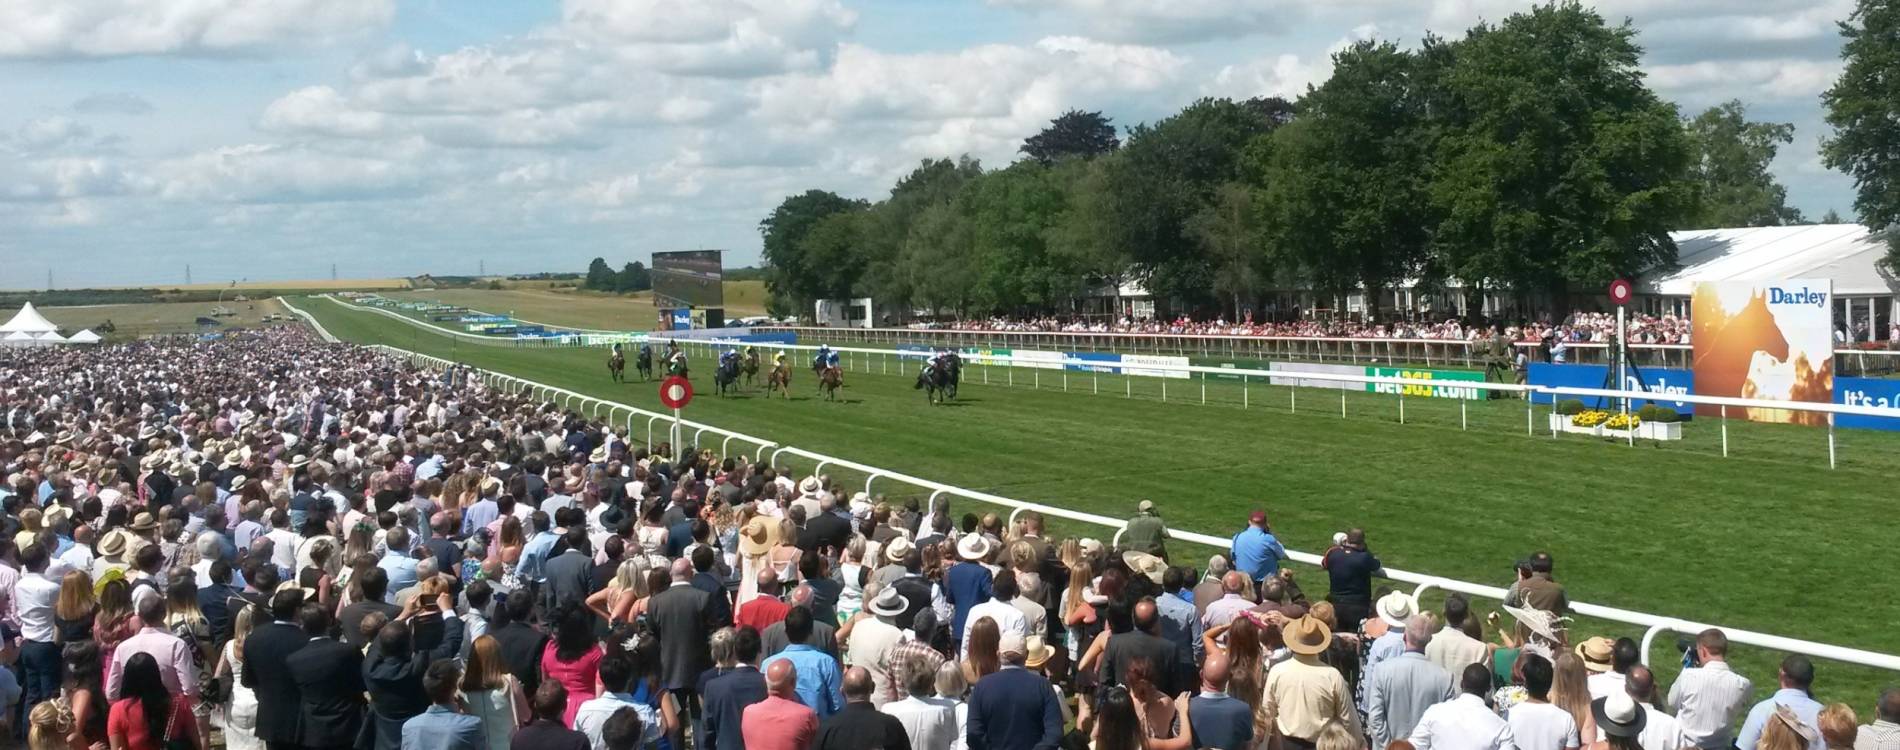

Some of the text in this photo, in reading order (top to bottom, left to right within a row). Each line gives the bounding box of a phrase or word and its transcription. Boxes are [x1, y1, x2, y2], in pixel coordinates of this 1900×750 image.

[1769, 286, 1827, 308] Darley
[1374, 367, 1479, 400] bet365.com
[1844, 390, 1873, 408] It's
[1877, 397, 1889, 409] a
